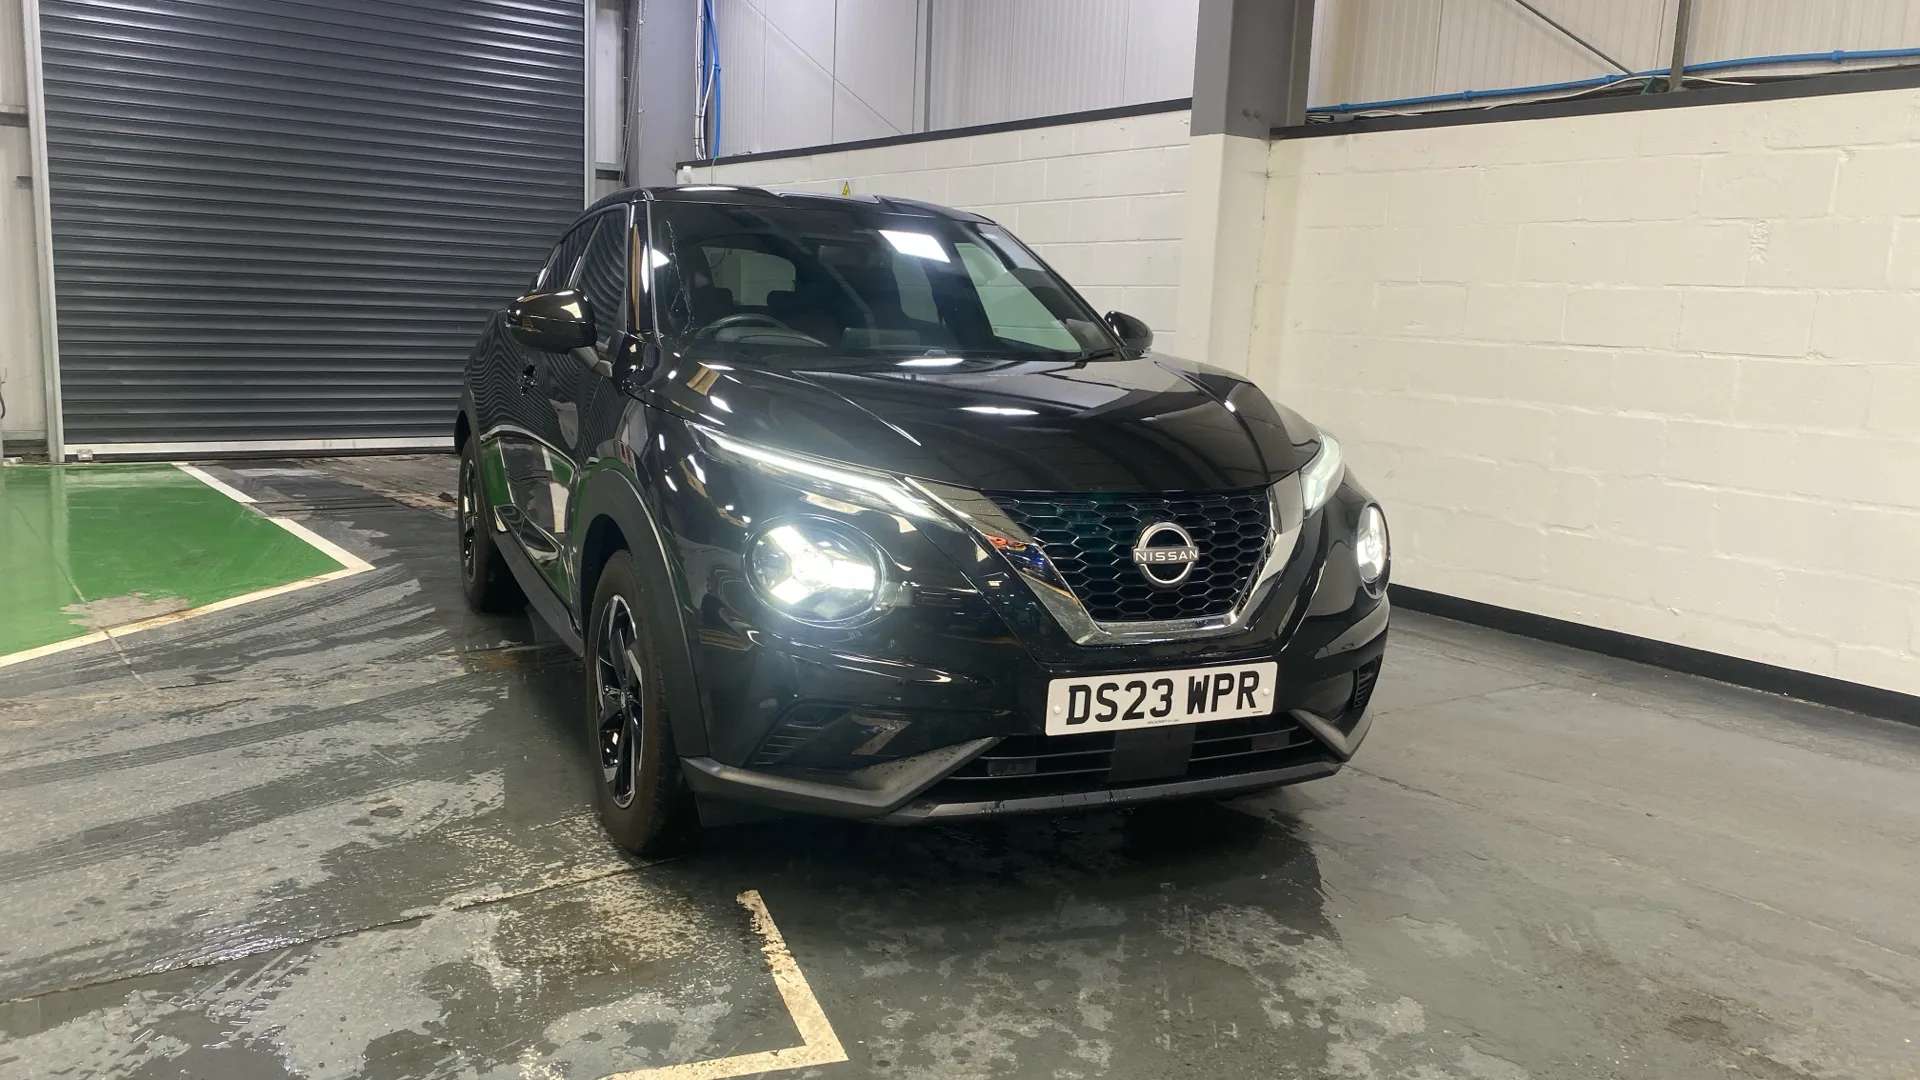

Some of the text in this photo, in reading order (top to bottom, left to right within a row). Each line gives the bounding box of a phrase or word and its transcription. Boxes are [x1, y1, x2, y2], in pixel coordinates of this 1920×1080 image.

[1135, 549, 1198, 562] NISSAN
[1066, 670, 1260, 725] DS23 WPR
